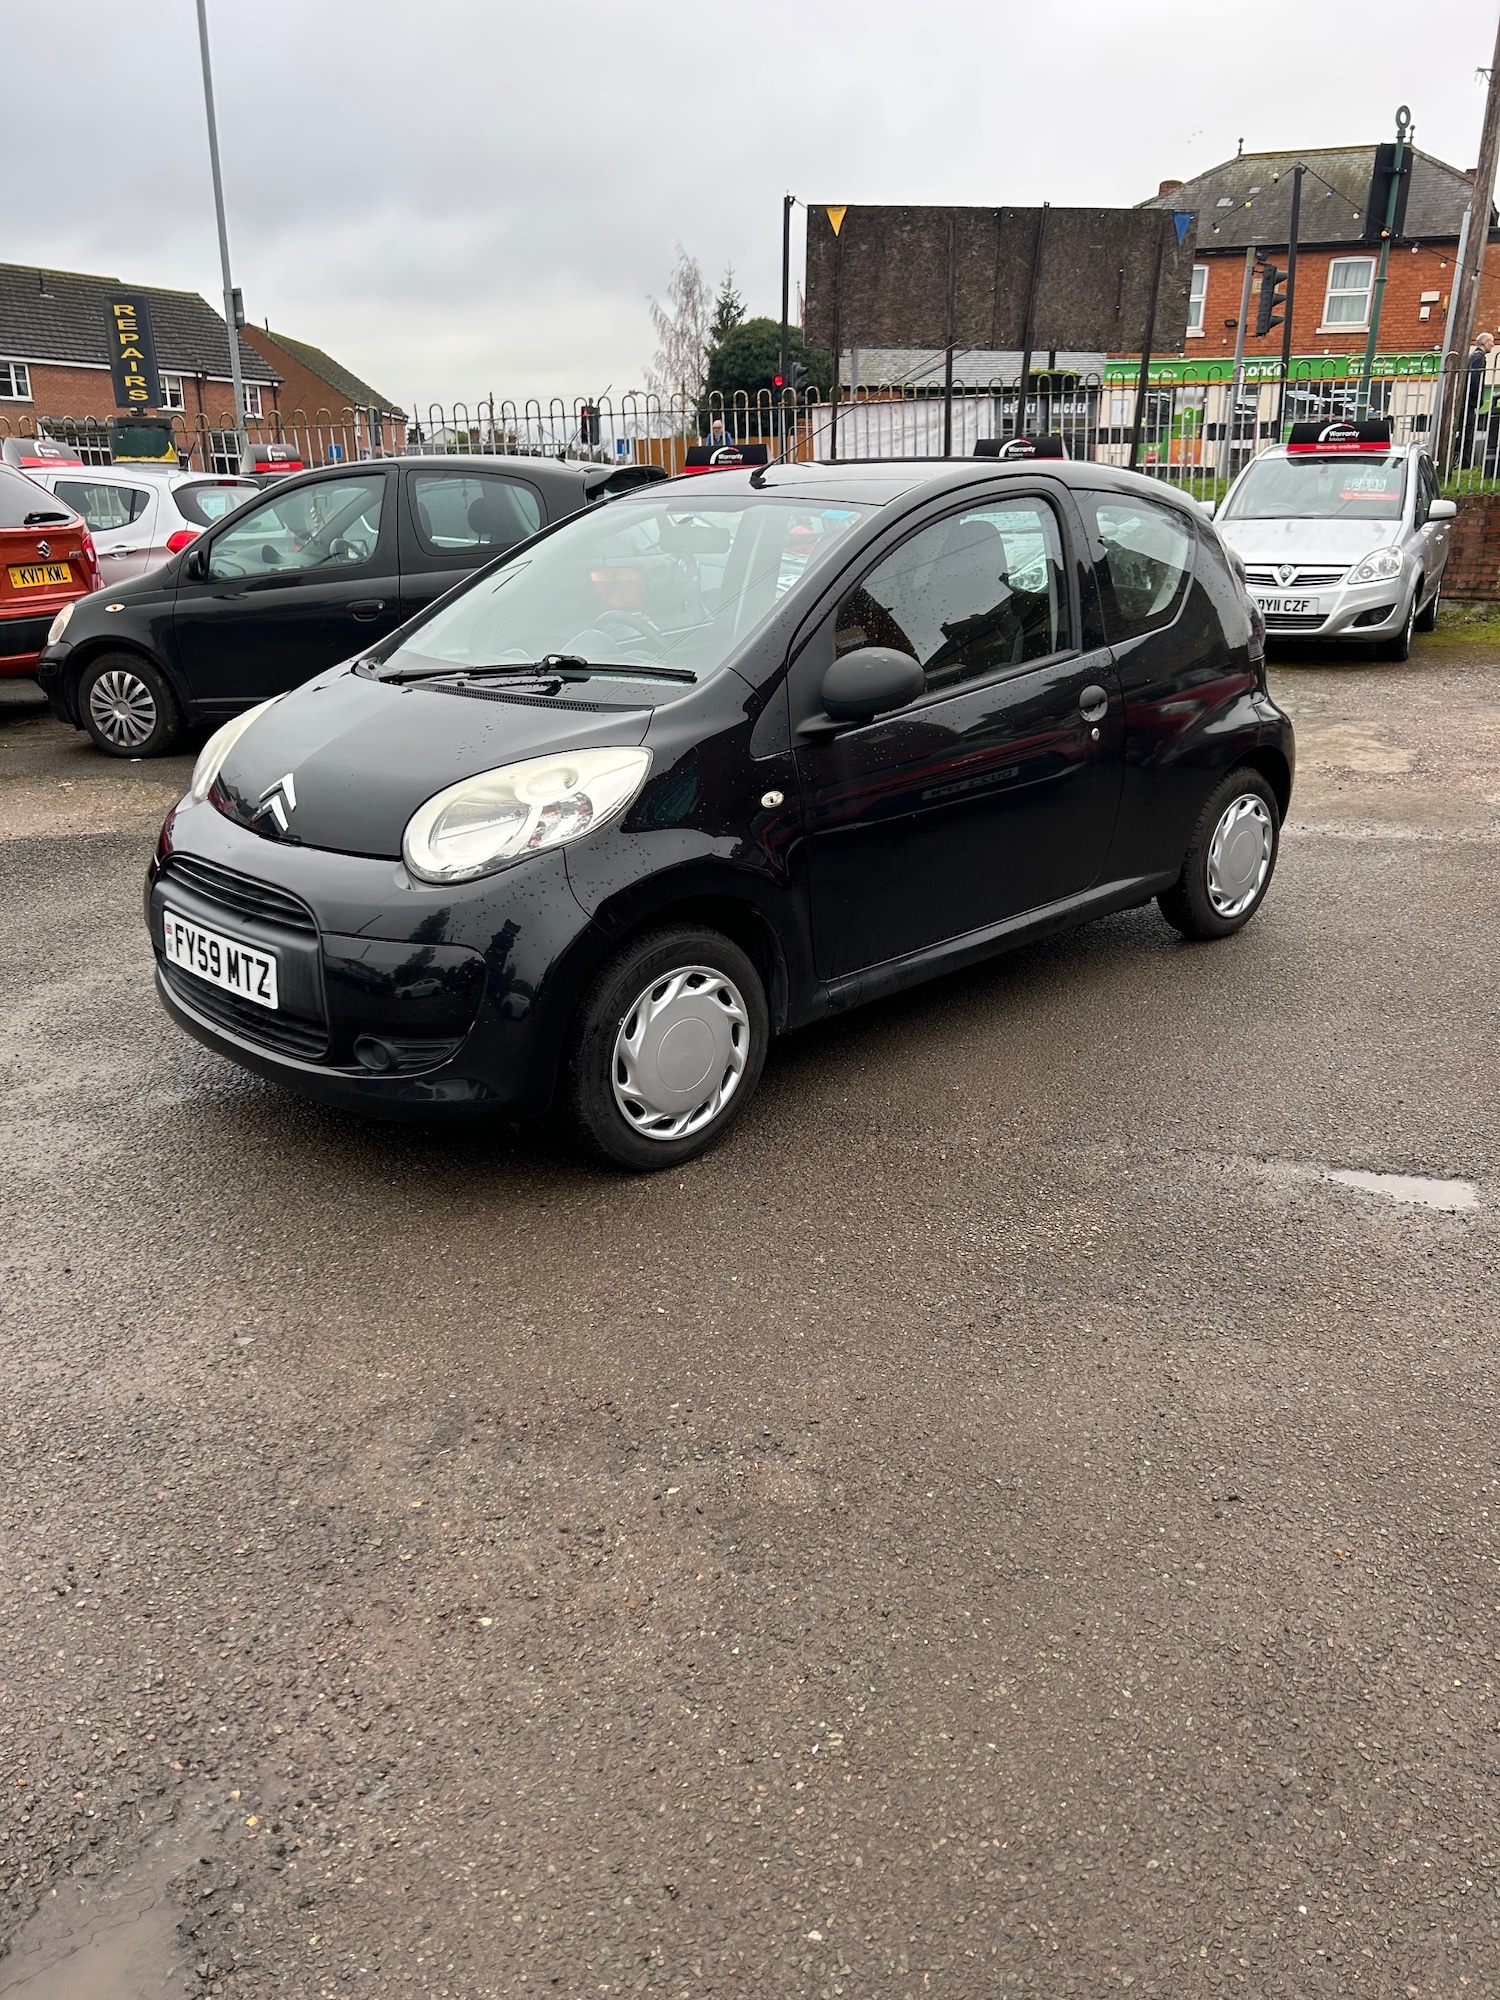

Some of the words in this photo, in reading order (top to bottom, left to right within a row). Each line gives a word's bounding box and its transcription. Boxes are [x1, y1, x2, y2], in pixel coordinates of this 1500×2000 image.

[113, 304, 149, 401] REPAIRS
[1329, 430, 1360, 438] Warranty
[1008, 446, 1036, 454] Warranty
[19, 567, 45, 585] KV17
[1257, 598, 1281, 612] DY11
[1283, 600, 1310, 612] CZF
[175, 923, 221, 978] FY59
[226, 946, 271, 1000] MTZ
